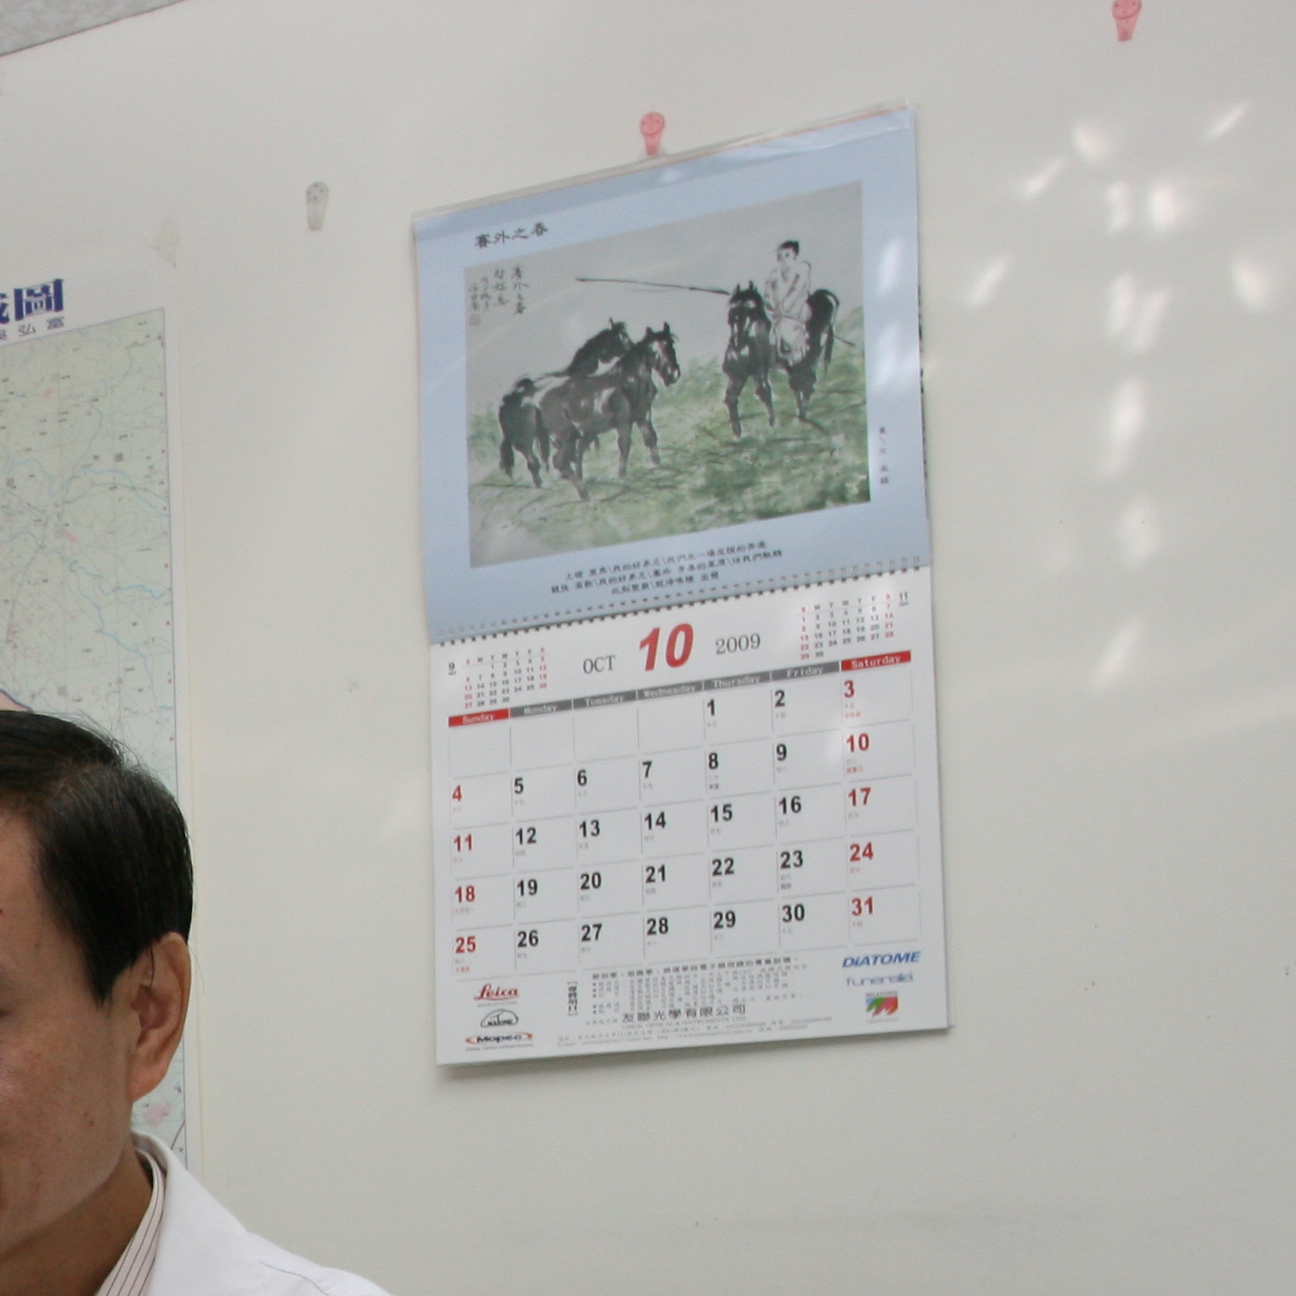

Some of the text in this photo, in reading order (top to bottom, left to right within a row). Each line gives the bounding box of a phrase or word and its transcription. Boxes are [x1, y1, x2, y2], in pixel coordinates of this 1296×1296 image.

[582, 622, 761, 674] OCT 10 2009
[462, 654, 901, 725] Sunday Monday Tuesday Wednesday Thursday Friday Saturday
[706, 680, 855, 716] 1 2 3
[452, 733, 870, 802] 4 5 6 7 8 9 10
[453, 787, 872, 852] 11 12 13 14 15 16 17
[454, 841, 874, 903] 18 19 20 21 22 23 24
[455, 896, 875, 954] 25 26 27 28 29 30 31
[842, 951, 921, 968] DIATOME
[473, 983, 519, 1001] Leica
